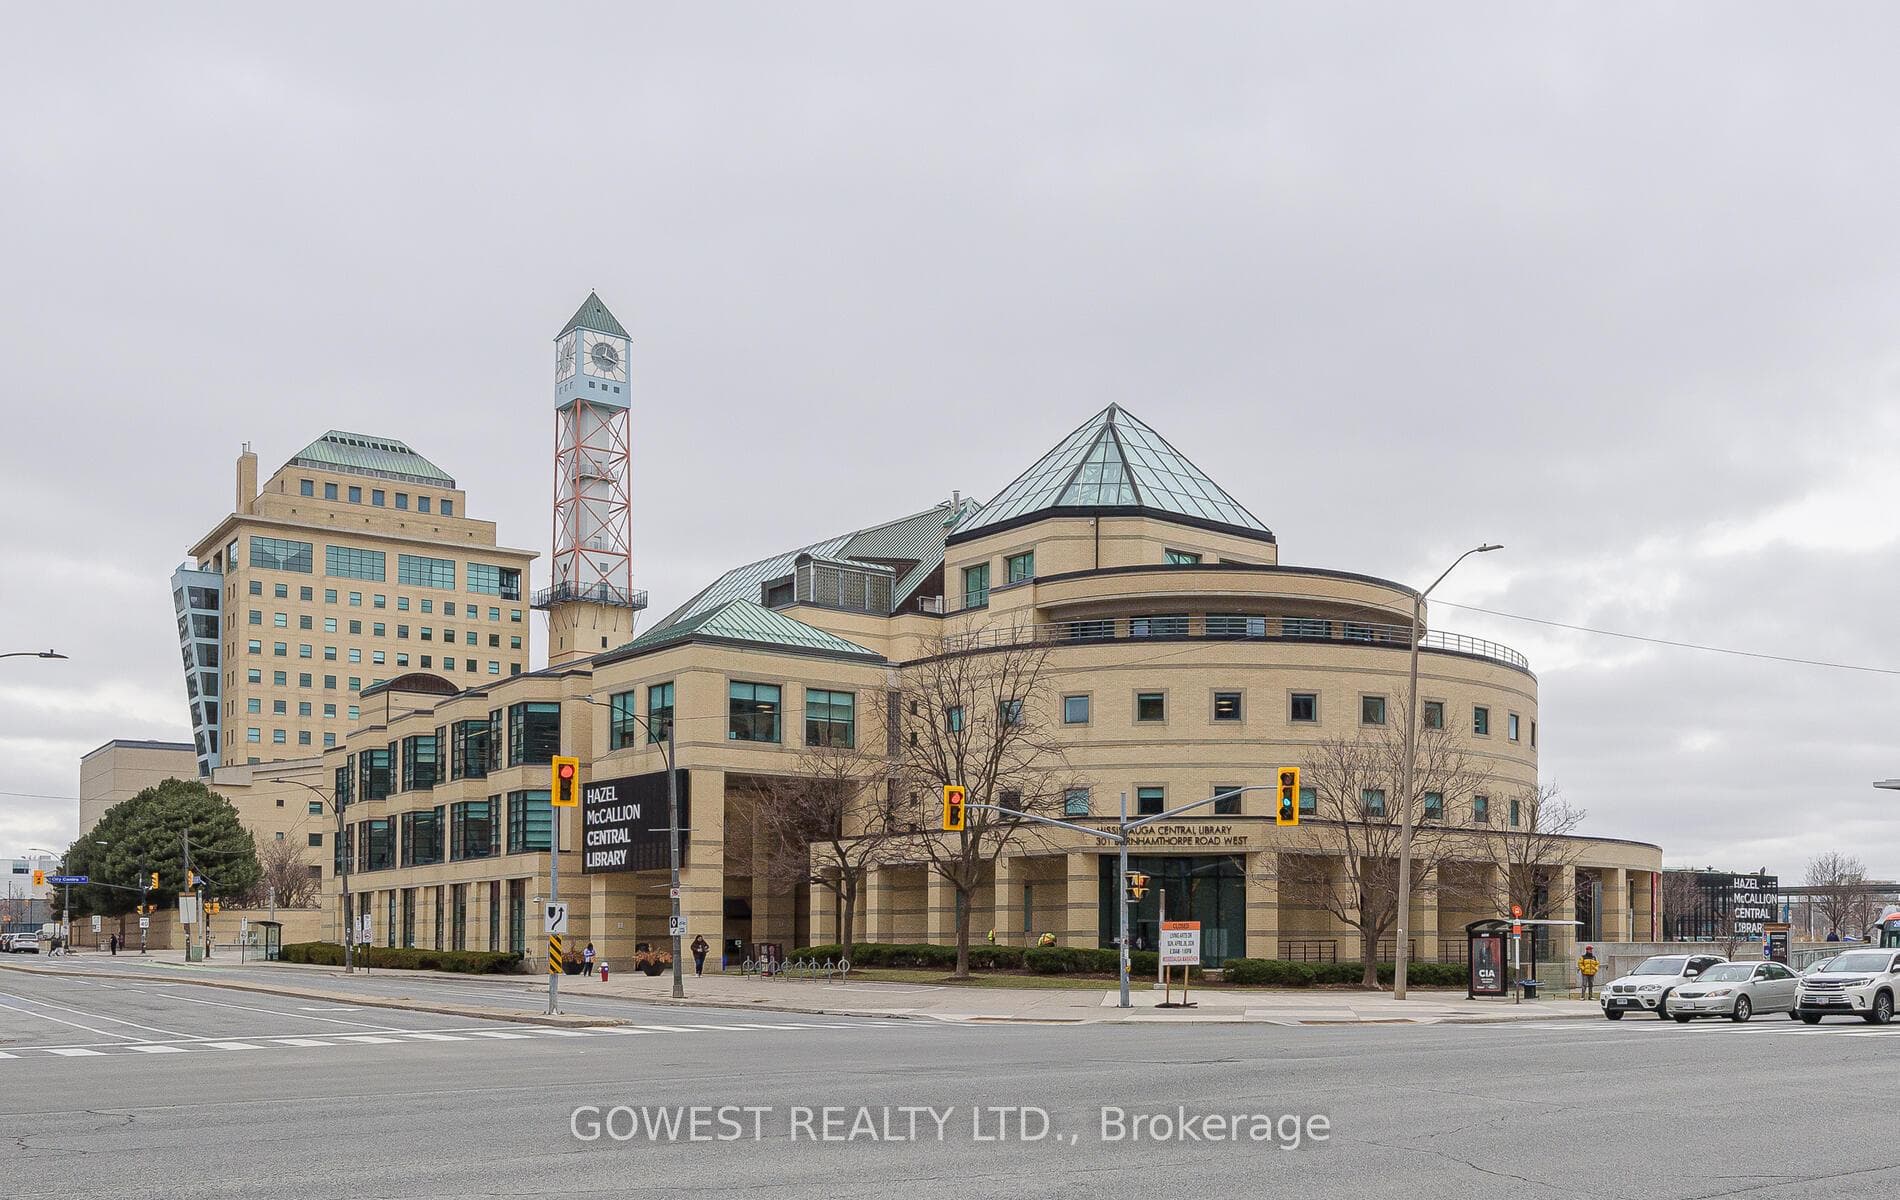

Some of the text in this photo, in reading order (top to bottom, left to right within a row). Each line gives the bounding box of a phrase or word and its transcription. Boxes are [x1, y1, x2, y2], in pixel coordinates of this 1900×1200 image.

[587, 786, 618, 804] HAZEL
[587, 804, 641, 825] McCALLION
[1158, 825, 1196, 835] CENTRAL
[1198, 825, 1232, 835] LIBRARY
[587, 828, 632, 847] CENTRAL
[1096, 836, 1248, 846] 301 BRNHAMTHORPE ROAD WEST
[587, 849, 627, 867] LIBRARY
[1734, 878, 1760, 889] HAZEL
[1734, 892, 1778, 904] McCALLION
[1734, 907, 1771, 919] CENTRAL
[1734, 922, 1765, 933] LIBRAR
[1479, 969, 1495, 978] CIA
